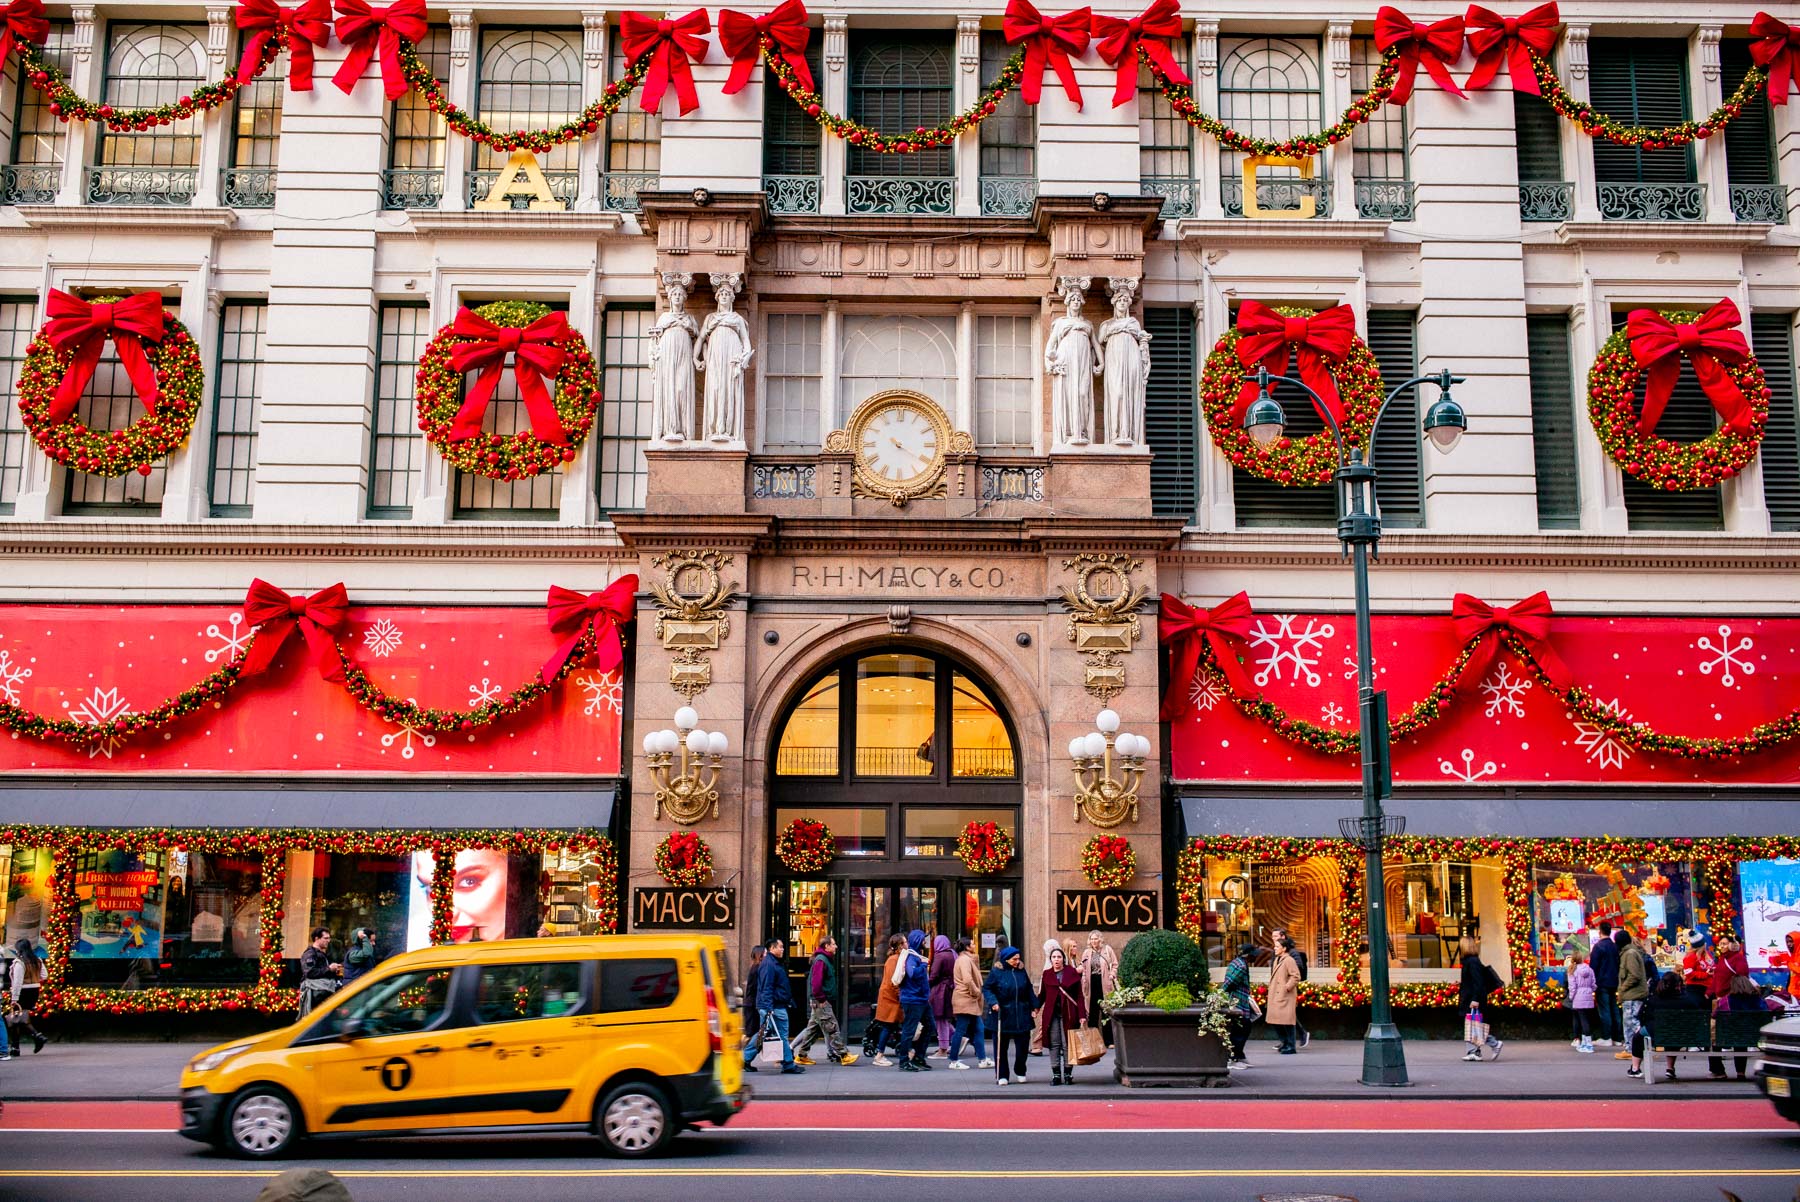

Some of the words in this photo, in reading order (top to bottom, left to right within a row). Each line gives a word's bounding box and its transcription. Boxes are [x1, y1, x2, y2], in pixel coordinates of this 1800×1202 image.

[474, 147, 566, 210] A
[1242, 154, 1316, 219] C
[90, 874, 122, 883] BRING
[126, 874, 155, 883] HOME
[1259, 866, 1289, 874] CHEERS
[1292, 866, 1301, 874] TO
[1259, 875, 1297, 883] GLAMOUR
[110, 886, 138, 897] WONDER
[100, 900, 141, 909] KIEHL'S
[639, 891, 730, 923] MACY'S
[1063, 894, 1154, 926] MACY'S
[385, 1063, 408, 1087] T
